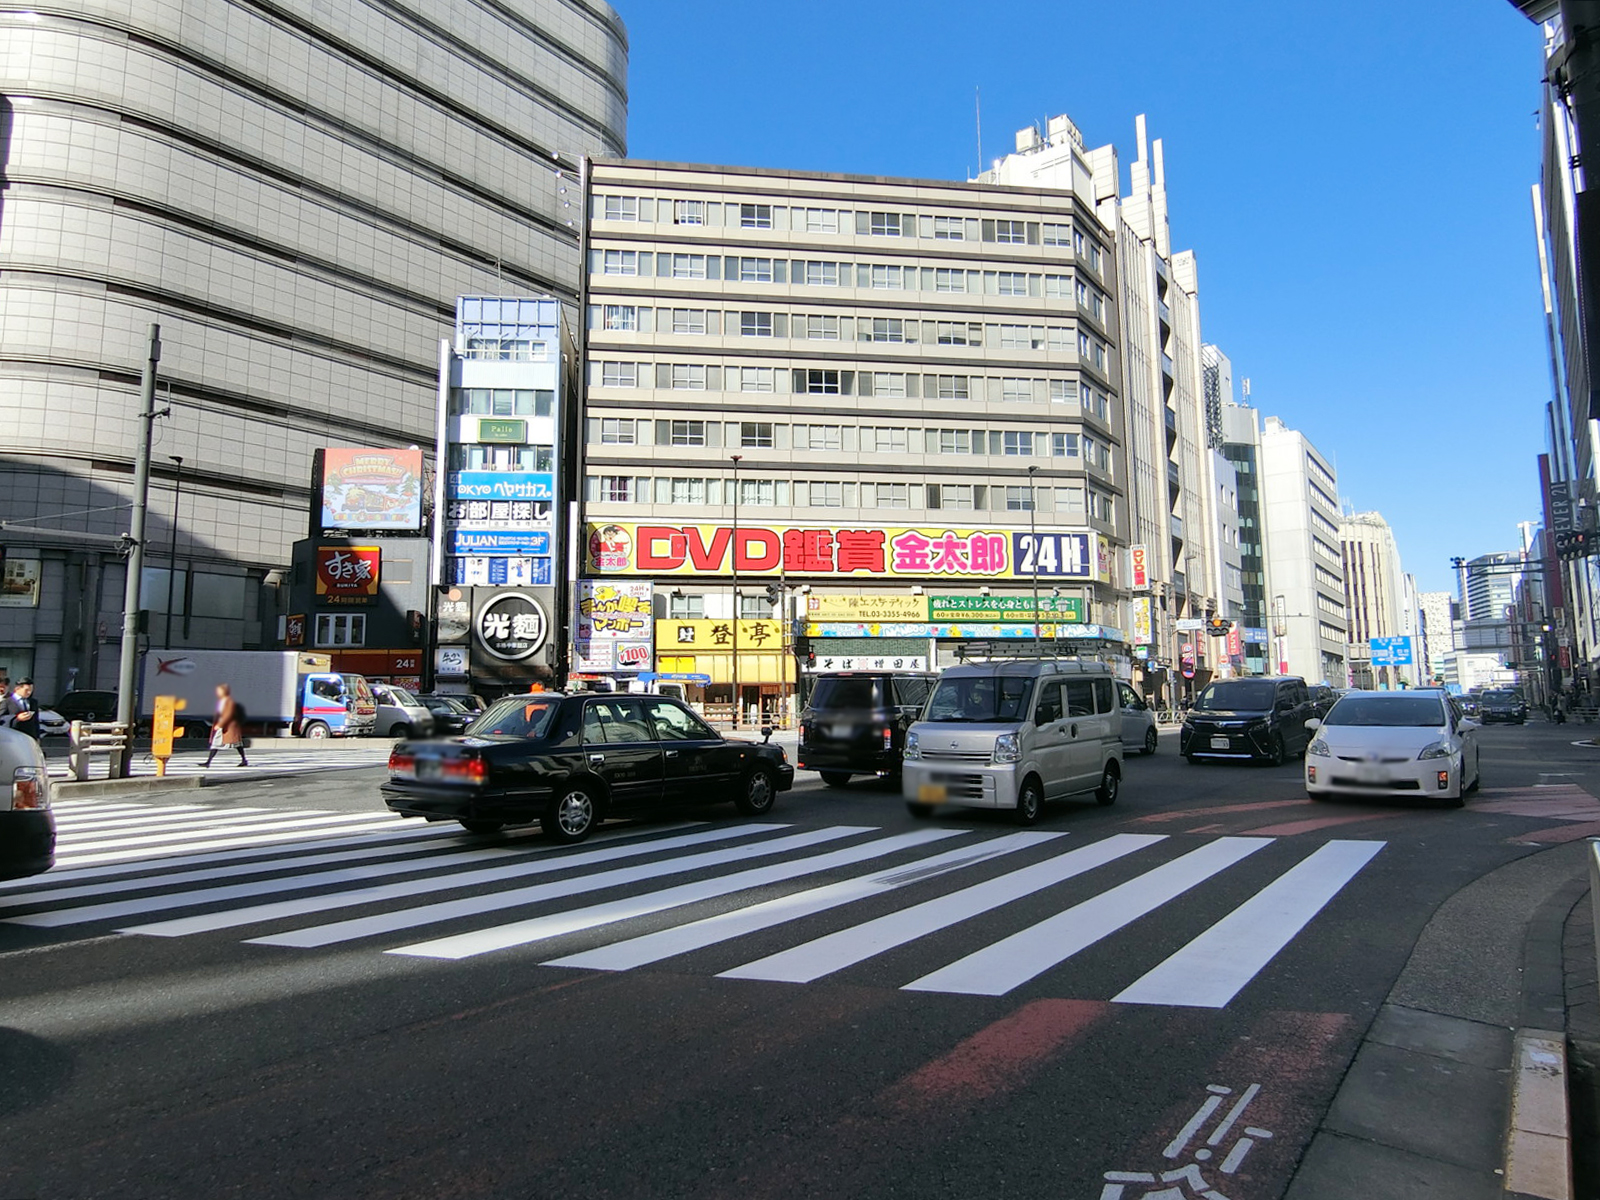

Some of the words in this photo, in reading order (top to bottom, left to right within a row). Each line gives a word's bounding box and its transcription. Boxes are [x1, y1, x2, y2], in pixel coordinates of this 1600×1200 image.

[450, 485, 492, 496] TOKYO
[448, 502, 552, 519] お部屋探し
[455, 534, 498, 547] JULIAN
[893, 532, 1006, 574] 金太郎
[1019, 533, 1083, 574] 24H
[325, 551, 372, 583] すき家
[595, 557, 627, 567] 金太郎
[594, 617, 644, 632] マンボー
[620, 647, 648, 662] ¥100
